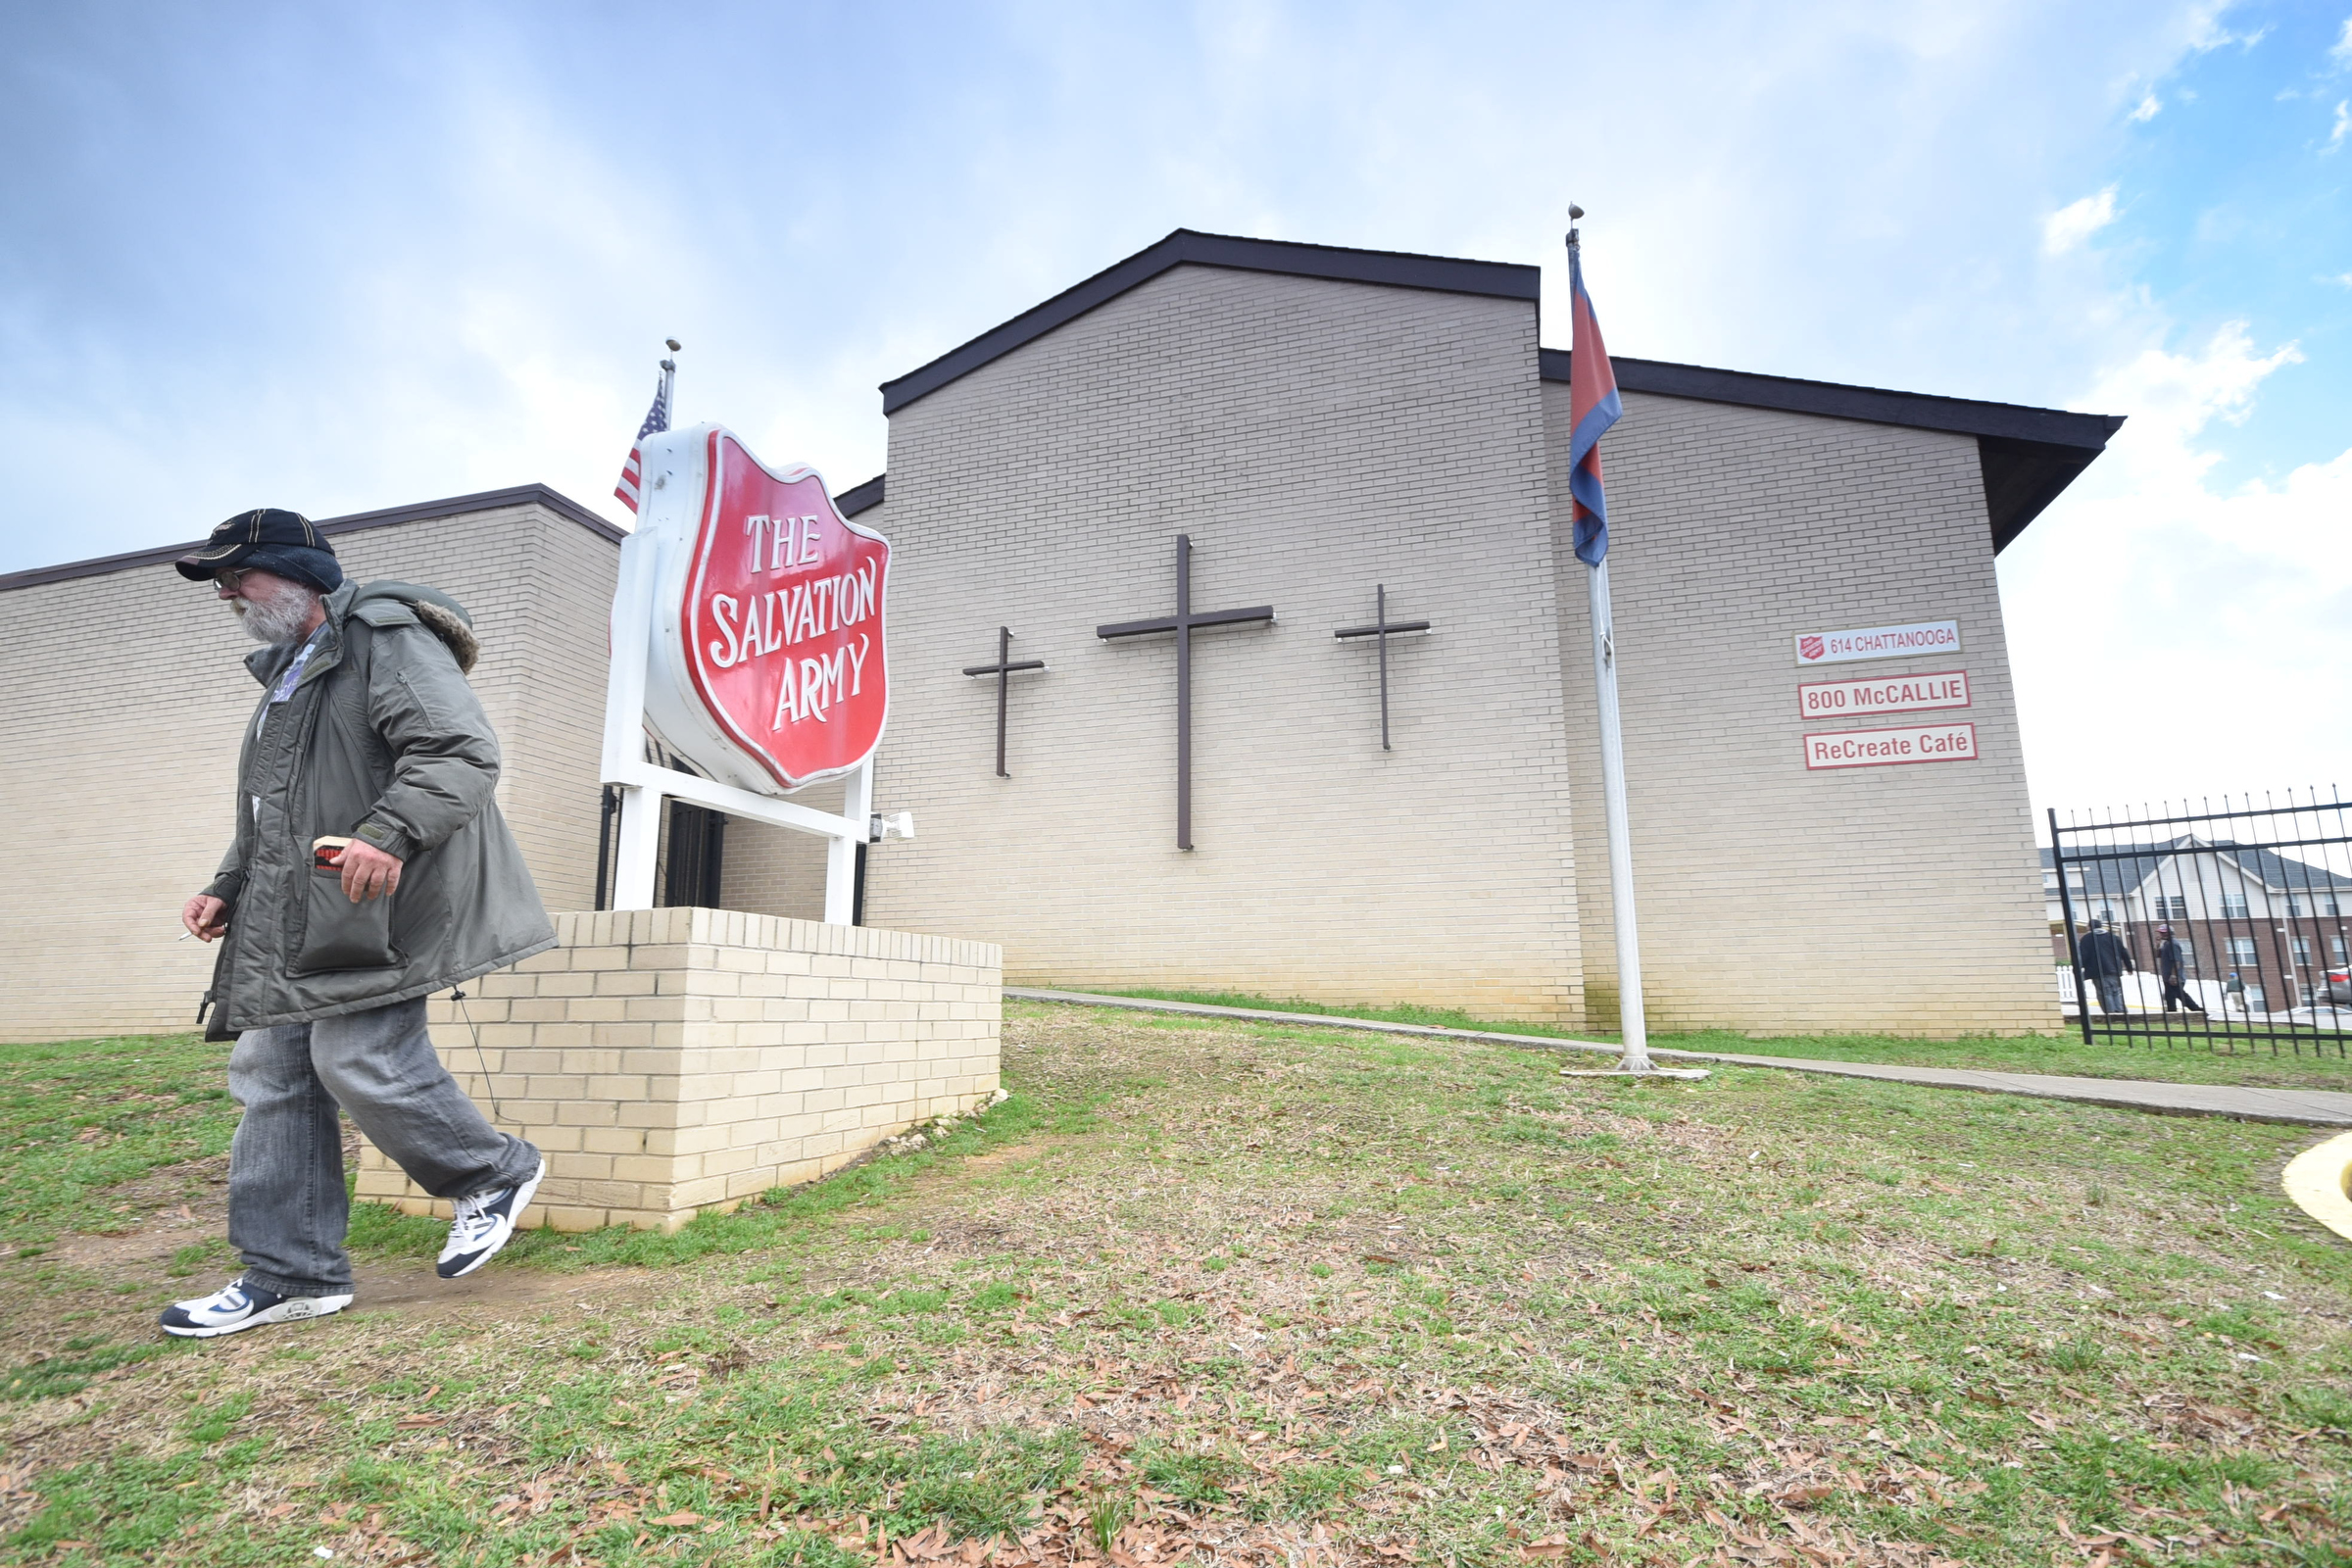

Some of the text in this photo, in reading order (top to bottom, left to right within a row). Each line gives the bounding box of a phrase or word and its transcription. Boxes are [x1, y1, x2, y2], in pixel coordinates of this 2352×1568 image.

[746, 514, 822, 574] THE
[709, 557, 877, 668] SALVATION
[1831, 638, 1852, 655] 614
[1855, 628, 1956, 652] CHATTANOOGA
[772, 633, 869, 732] ARMY
[1808, 680, 1963, 710] 800 McCALLIE
[1815, 732, 1968, 760] ReCreate Café
